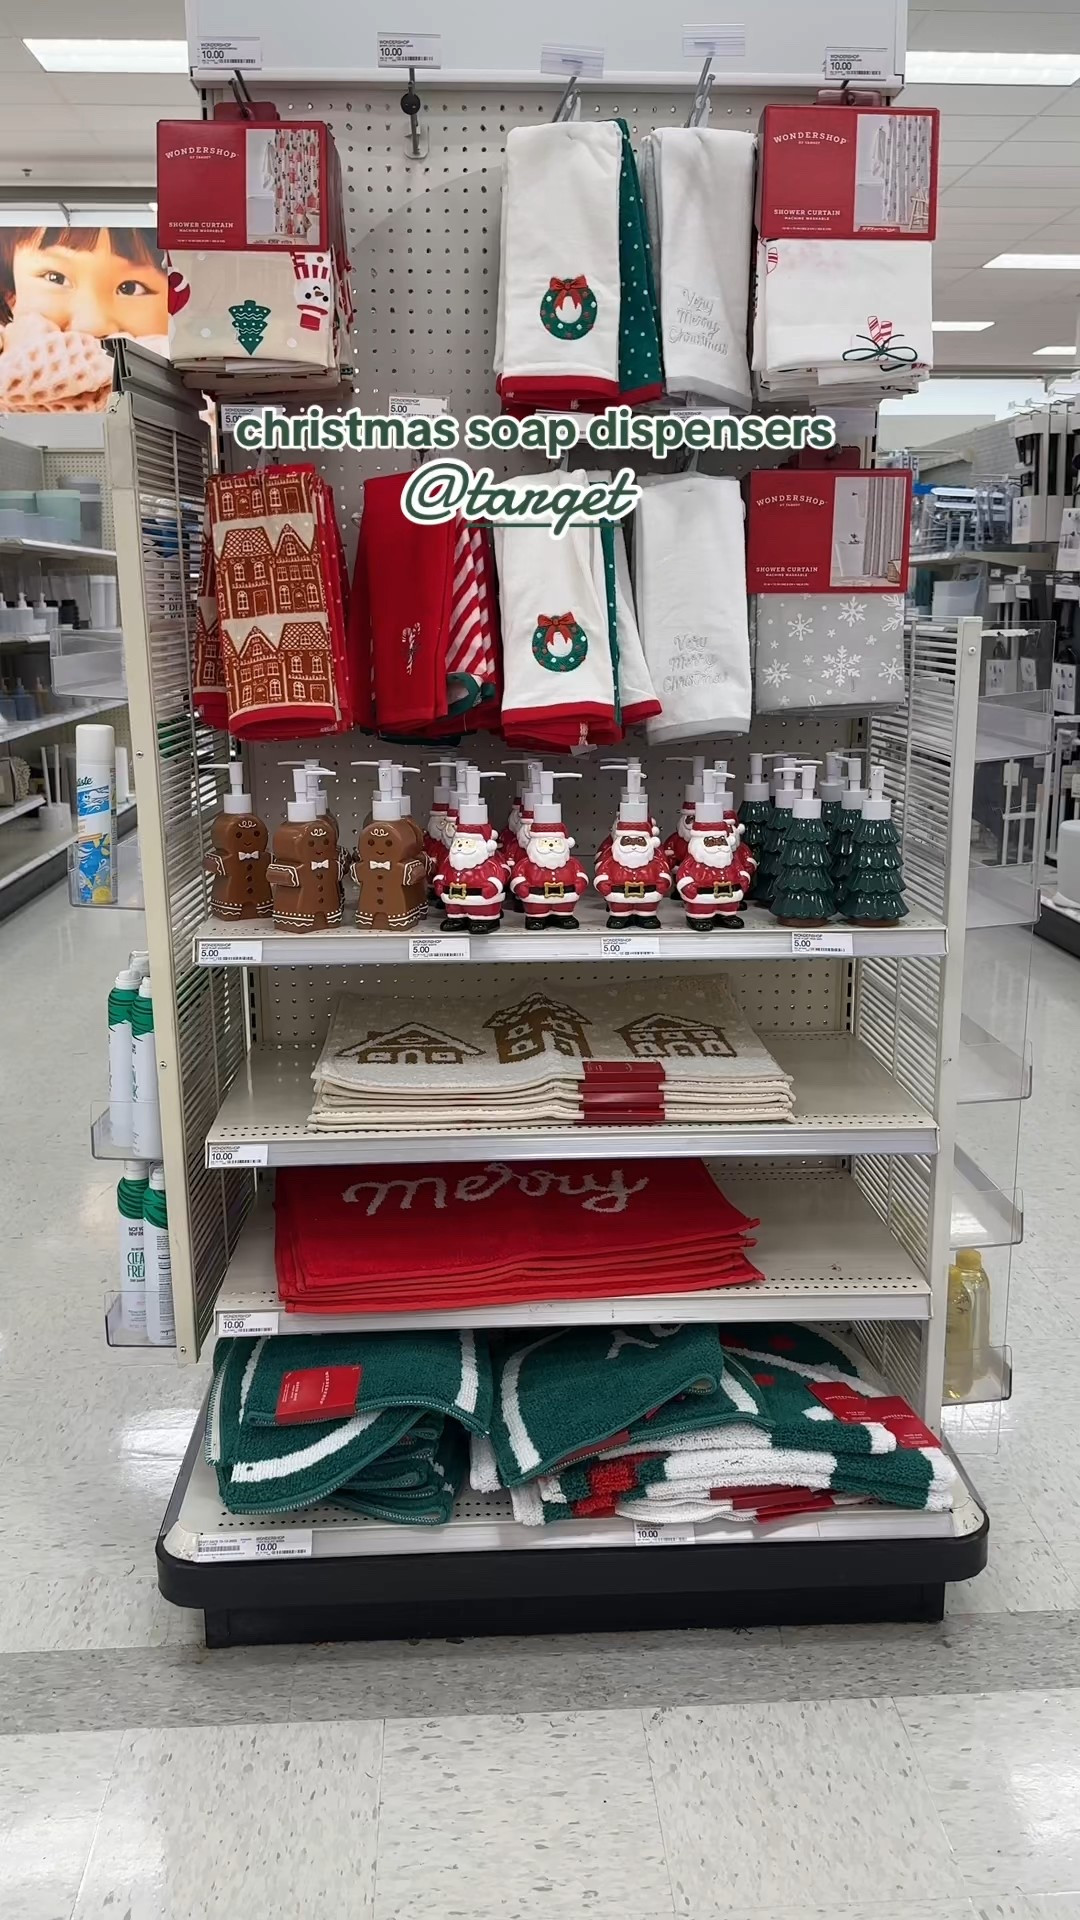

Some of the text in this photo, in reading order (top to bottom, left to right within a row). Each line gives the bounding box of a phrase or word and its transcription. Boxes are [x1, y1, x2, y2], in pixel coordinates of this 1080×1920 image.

[201, 50, 225, 58] 10.00
[380, 48, 403, 56] 10.00
[830, 62, 852, 70] 10.00
[772, 131, 848, 145] WONDERSHOP
[165, 146, 237, 159] WONDERSHOP
[390, 404, 408, 413] 5.00
[756, 494, 826, 507] WONDERSHOP
[201, 949, 219, 957] 5.00
[223, 1320, 244, 1329] 10.00
[256, 1542, 277, 1551] 10.00
